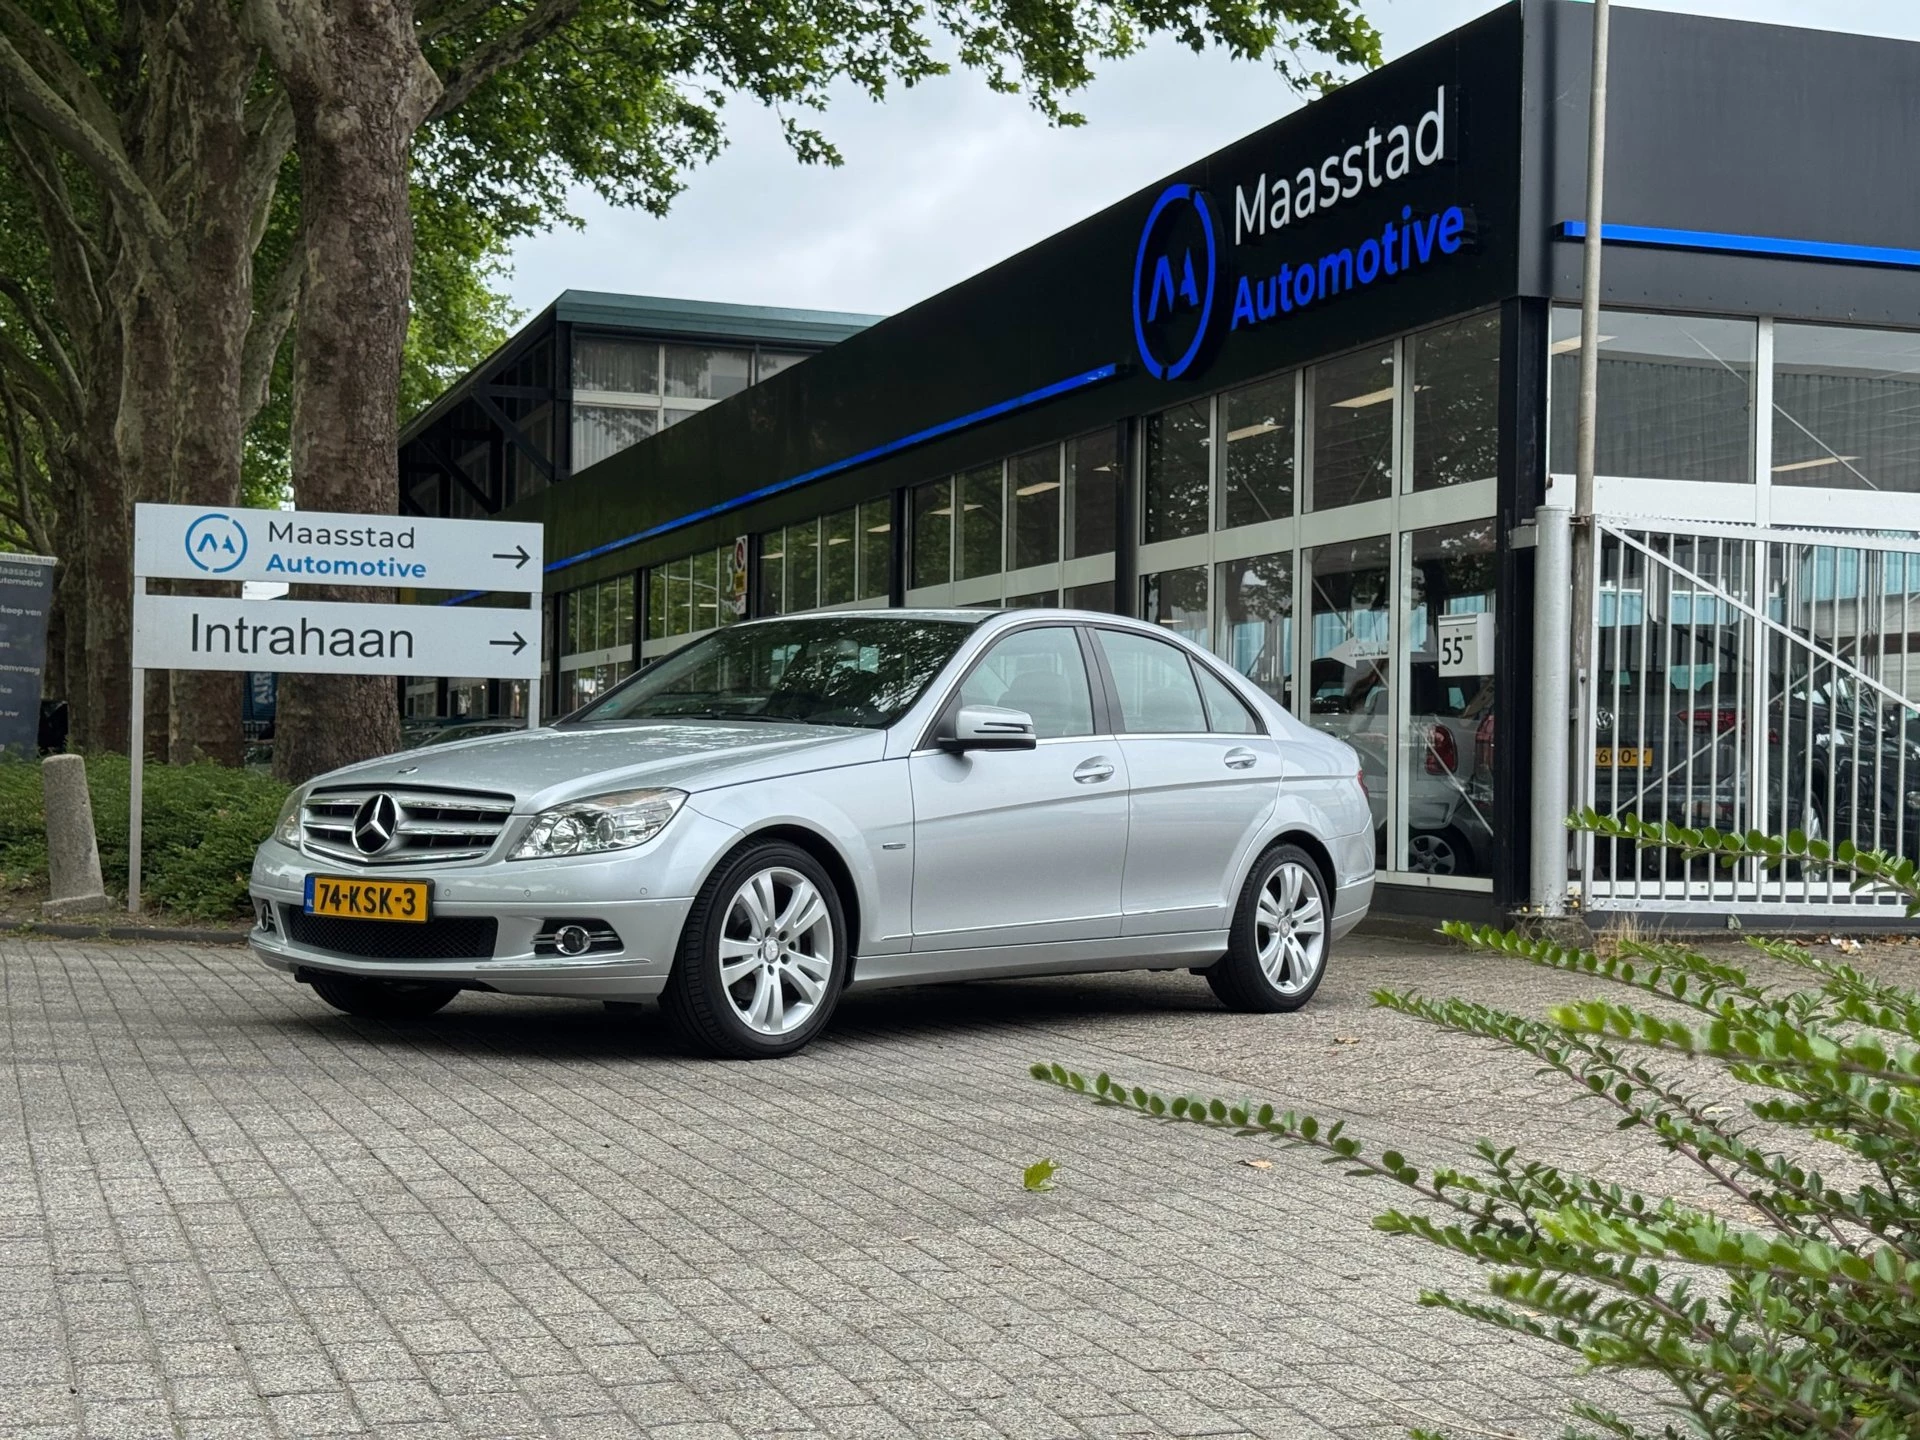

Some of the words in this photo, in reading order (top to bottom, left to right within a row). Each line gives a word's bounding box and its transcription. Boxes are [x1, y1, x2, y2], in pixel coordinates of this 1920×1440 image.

[1235, 84, 1445, 246] Maasstad
[1230, 204, 1465, 332] Automotive
[268, 520, 415, 550] Maasstad
[265, 553, 428, 579] Automotive
[191, 612, 414, 659] Intrahaan
[1441, 636, 1464, 666] 55
[318, 883, 417, 916] 74-KSK-3
